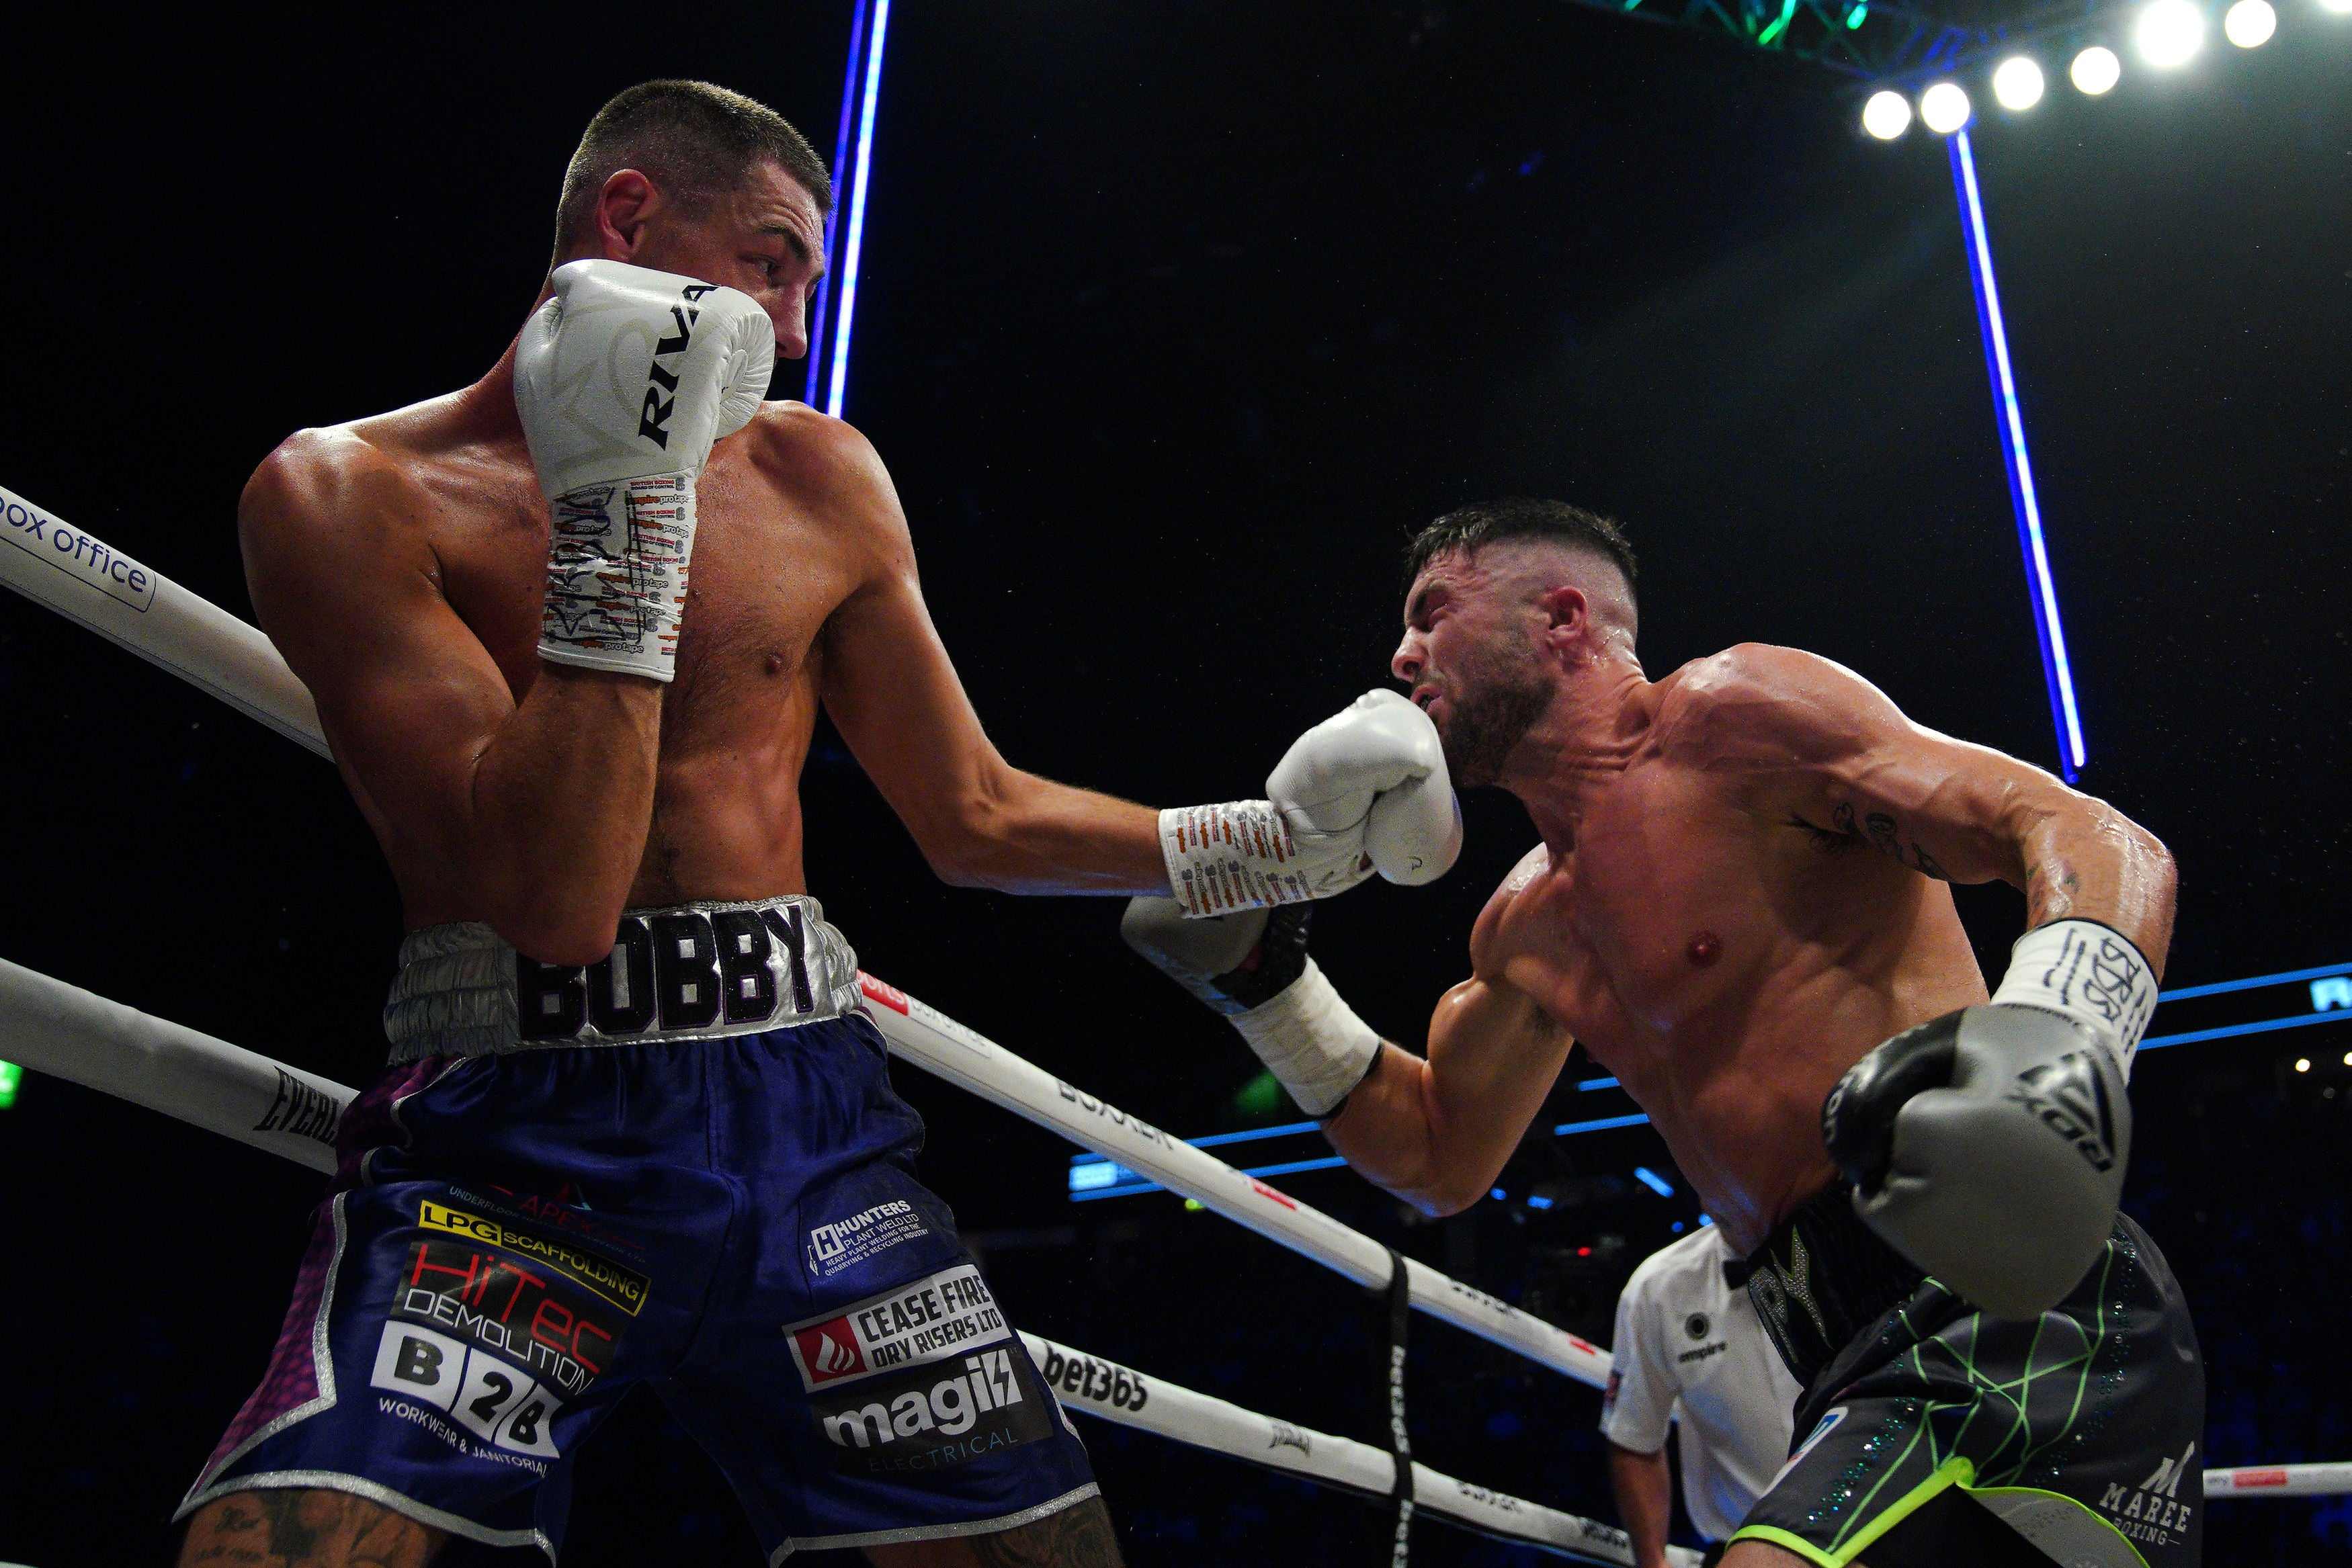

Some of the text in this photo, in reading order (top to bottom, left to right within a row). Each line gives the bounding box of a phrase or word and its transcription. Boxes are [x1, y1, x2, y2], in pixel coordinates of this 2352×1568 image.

[53, 528, 146, 593] office
[516, 904, 814, 1041] BOBBY
[826, 1222, 921, 1267] HEAVY PLANT WELDING FOR THE
[834, 1200, 911, 1237] HUNTERS
[843, 1213, 919, 1249] PLANT WELD LTD
[423, 1206, 499, 1242] LPG
[503, 1231, 640, 1302] SCAFFOLDING
[825, 1255, 864, 1276] QUARRYING
[869, 1235, 905, 1255] RECYCLING
[903, 1228, 929, 1241] INDUSTRY
[857, 1275, 991, 1343] CEASE FIRE
[871, 1307, 1003, 1368] DRY RISERS LTD
[405, 1288, 595, 1395] DEMOLITION
[394, 1335, 547, 1445] B2B
[1043, 1339, 1148, 1412] bet365
[379, 1397, 458, 1446] WORKWEAR
[460, 1439, 467, 1454] &
[869, 1427, 1019, 1473] ELECTRICAL
[2099, 1482, 2192, 1533] MAREE
[2113, 1516, 2169, 1546] BOXING
